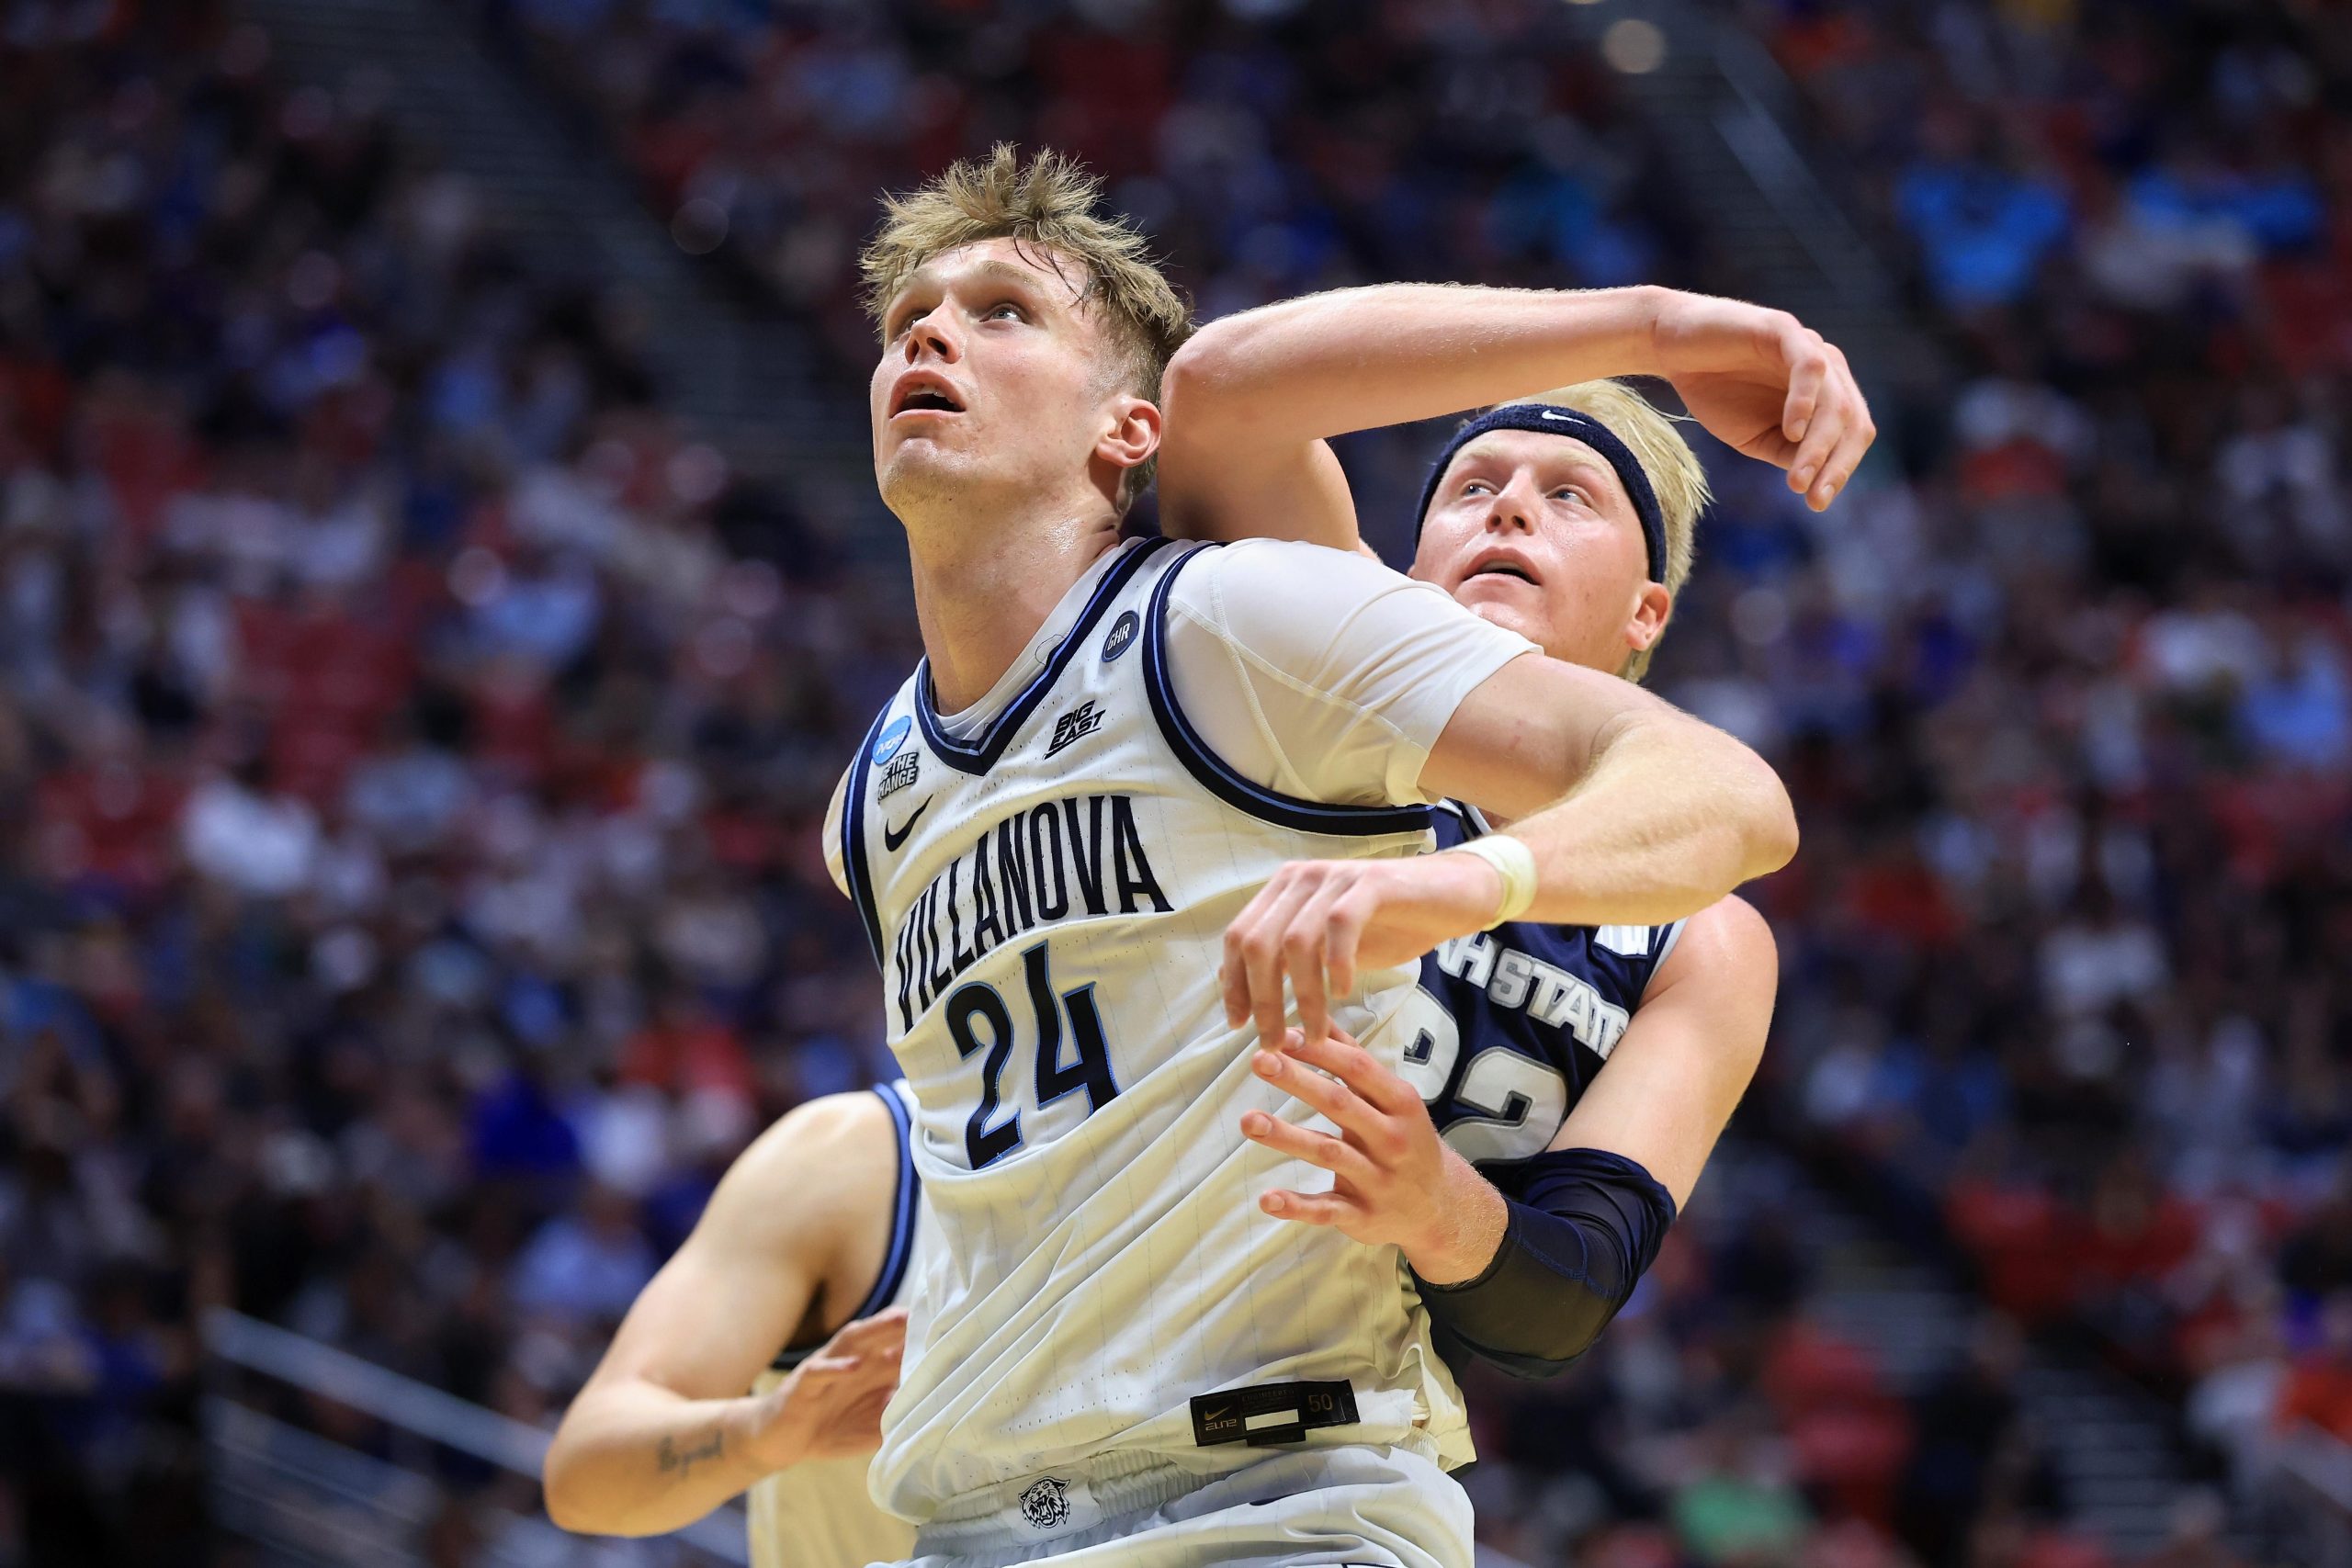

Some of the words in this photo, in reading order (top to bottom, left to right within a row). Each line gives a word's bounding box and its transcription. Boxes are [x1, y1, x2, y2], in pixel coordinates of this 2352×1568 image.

[1047, 708, 1106, 751] EAST
[1054, 699, 1096, 735] BIG
[890, 752, 918, 774] THE
[878, 767, 918, 800] HANGE
[896, 795, 1175, 1036] VILLANOVA
[944, 939, 1122, 1170] 24
[1307, 1393, 1333, 1413] 50
[1204, 1418, 1238, 1432] ELITE
